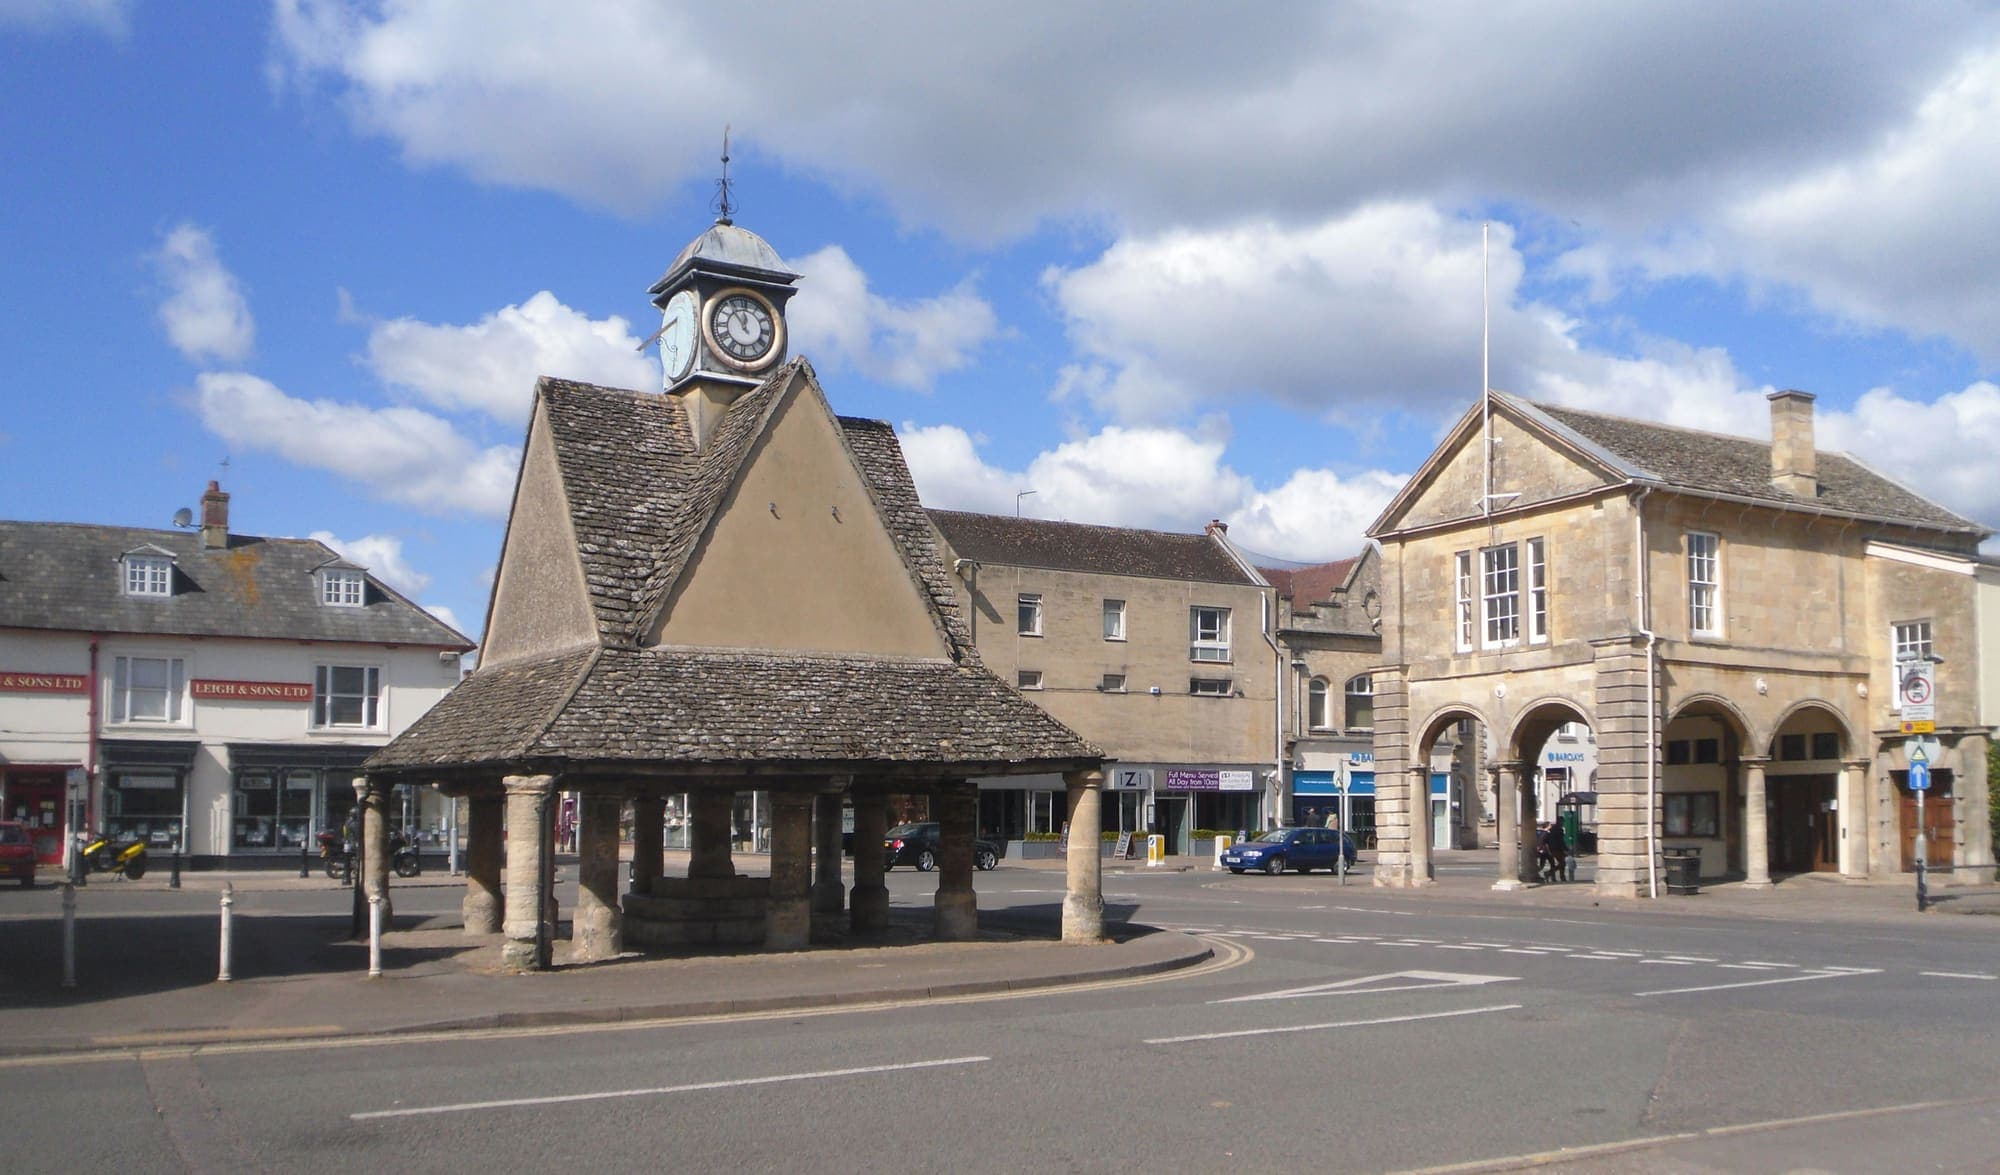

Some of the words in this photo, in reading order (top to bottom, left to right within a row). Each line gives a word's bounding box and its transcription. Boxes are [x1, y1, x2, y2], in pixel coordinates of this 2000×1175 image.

[4, 677, 14, 687] &
[17, 677, 52, 688] SONS
[55, 678, 82, 689] LTD
[195, 683, 234, 694] LEIGH
[238, 685, 248, 695] &
[250, 685, 281, 696] SONS
[284, 687, 308, 697] LTD
[1556, 753, 1584, 761] BARCLAYS
[1198, 771, 1218, 779] Served
[1177, 779, 1188, 787] Day
